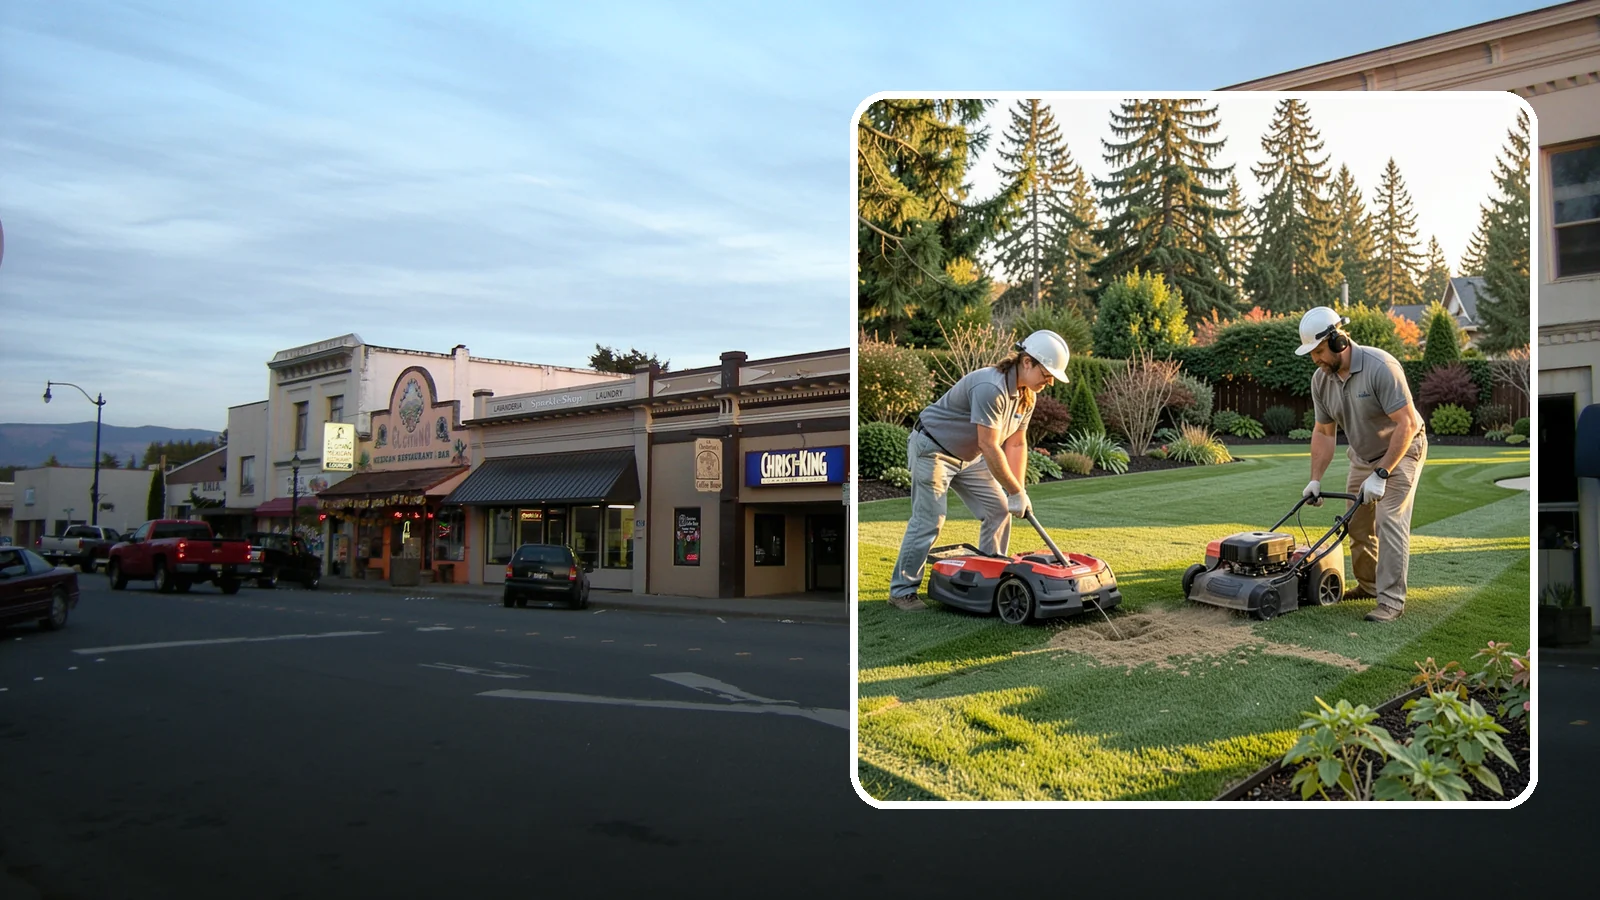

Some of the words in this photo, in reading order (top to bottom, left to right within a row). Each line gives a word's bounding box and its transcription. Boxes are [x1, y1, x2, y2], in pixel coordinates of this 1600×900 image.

[562, 394, 582, 404] Shop
[595, 389, 623, 400] LAUNDRY
[494, 403, 522, 412] LAVANDERIA
[397, 451, 433, 462] RESTAURANT
[437, 450, 450, 459] BAR
